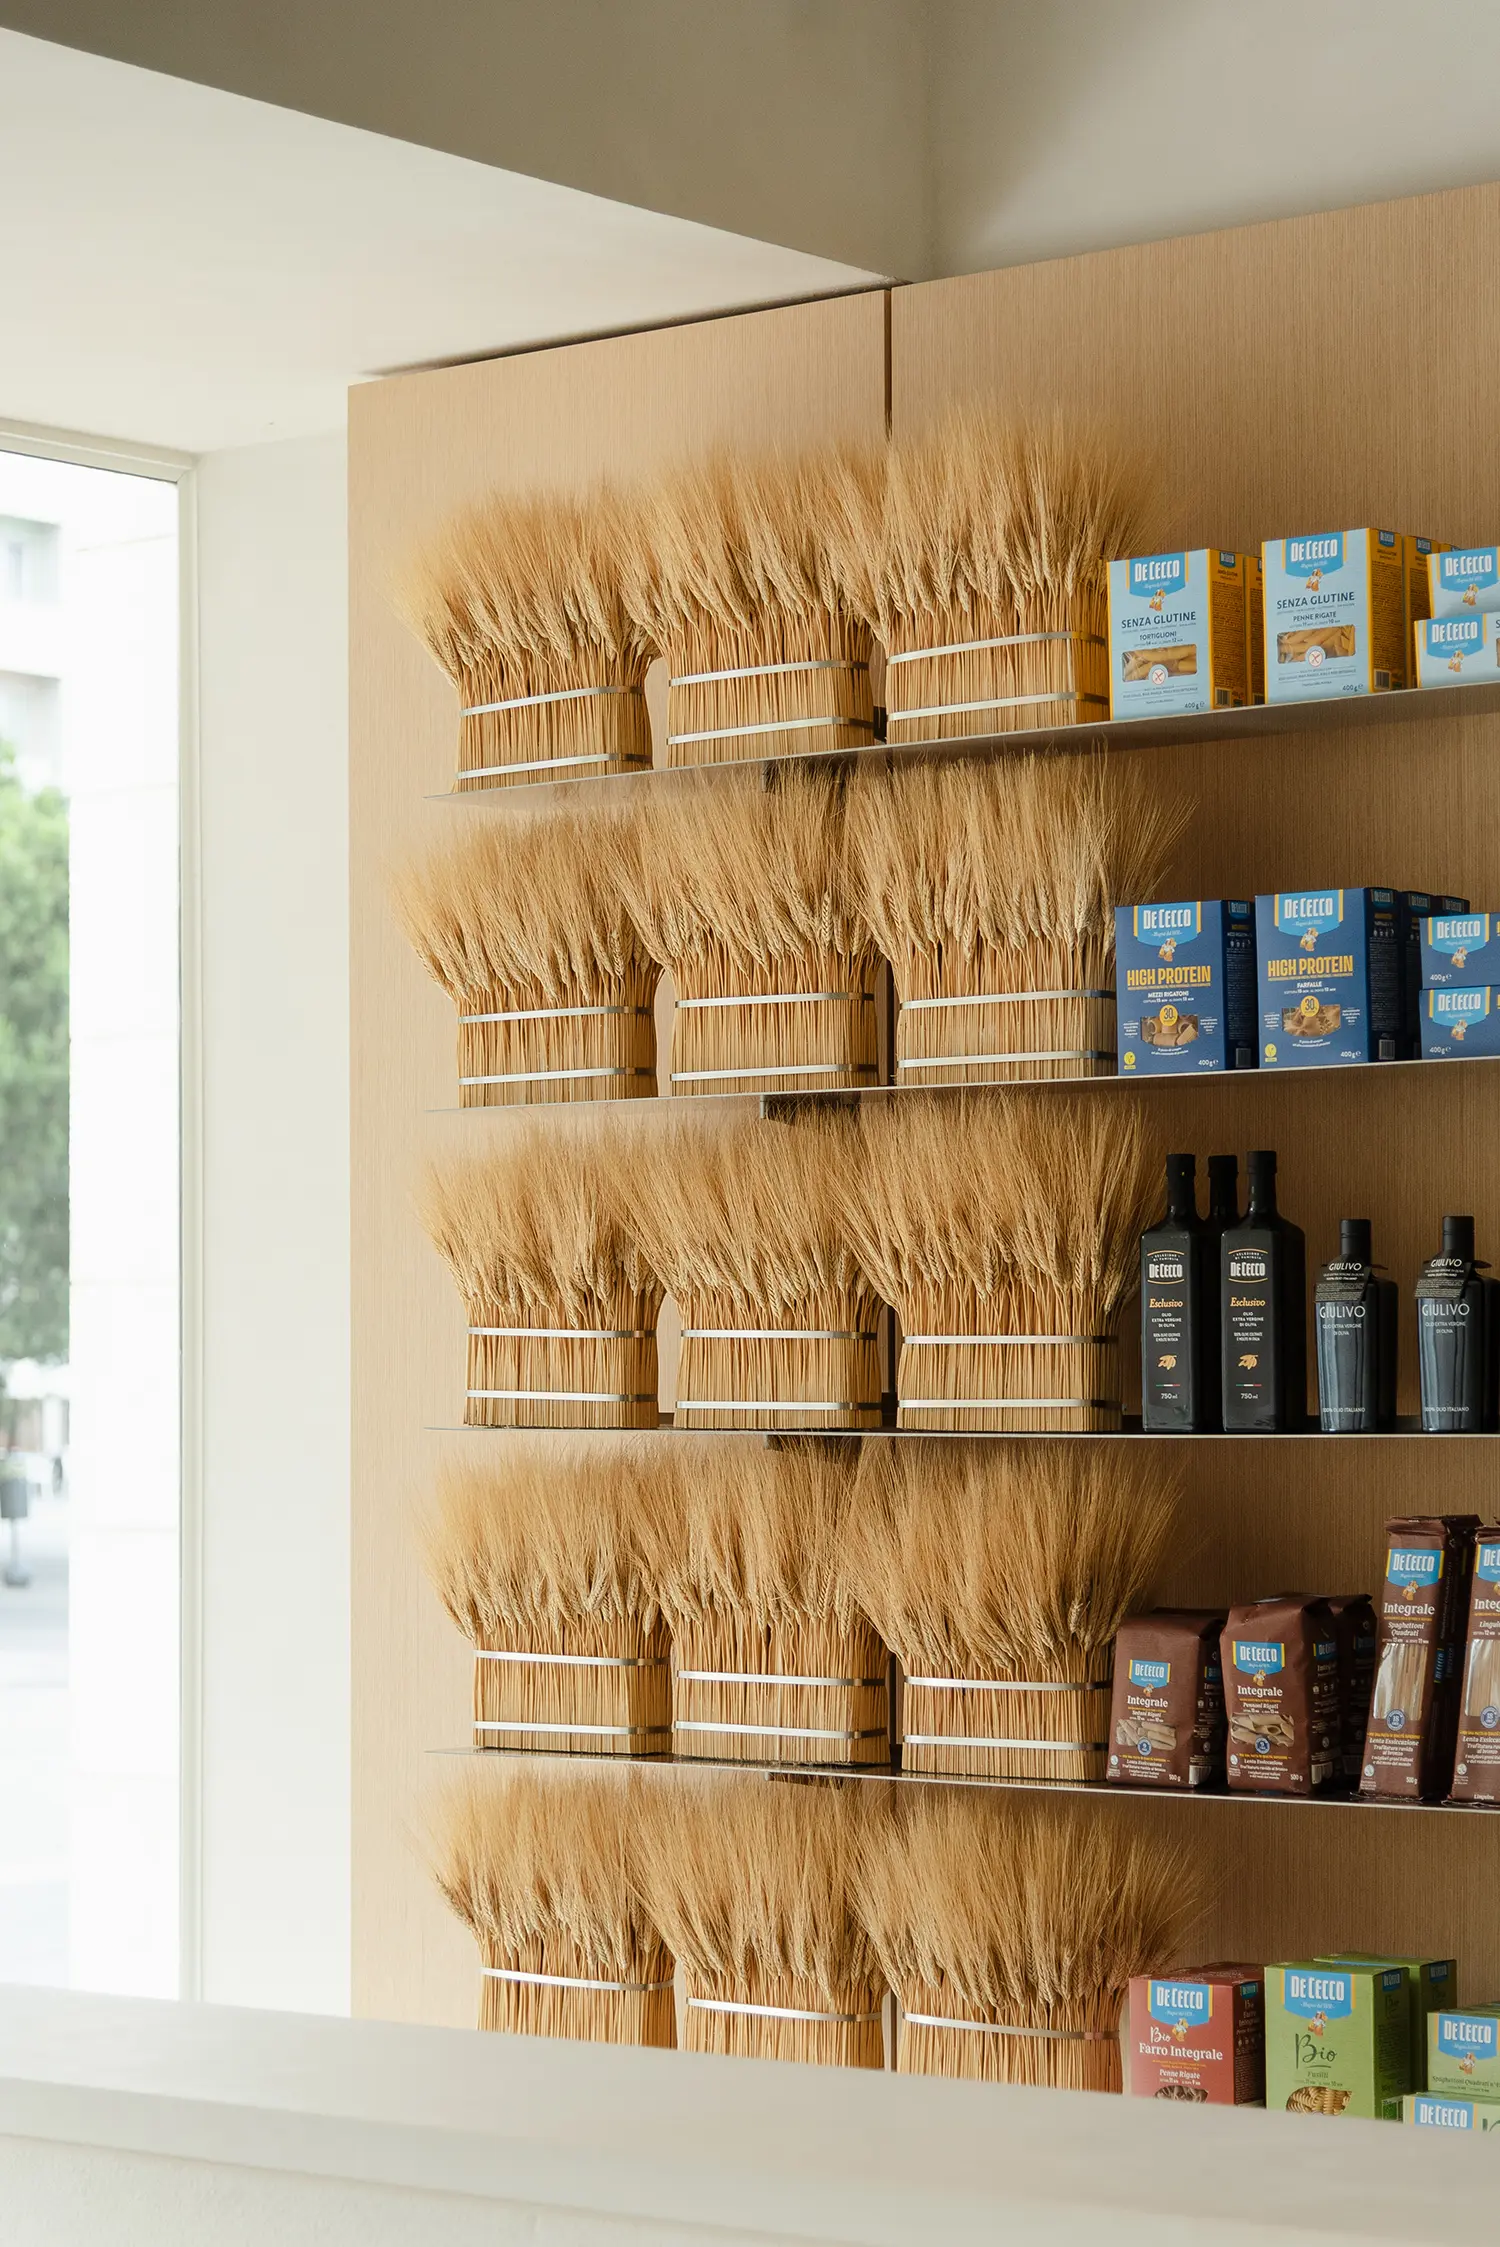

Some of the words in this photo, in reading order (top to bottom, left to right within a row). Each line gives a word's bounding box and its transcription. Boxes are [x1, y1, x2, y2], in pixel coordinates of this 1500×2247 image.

[1277, 597, 1308, 610] SENZA
[1310, 592, 1355, 604] GLUTINE
[1121, 616, 1152, 629] SENZA
[1153, 611, 1196, 624] GLUTINE
[1293, 613, 1314, 622] PENNE
[1314, 611, 1336, 620] RIGATE
[1140, 631, 1177, 640] TORTIGLIONI
[1268, 959, 1296, 977] HIGH
[1299, 956, 1353, 975] PROTEIN
[1127, 968, 1155, 986] HIGH
[1158, 966, 1211, 984] PROTEIN
[1305, 998, 1314, 1010] 30
[1164, 1008, 1173, 1019] 30
[1329, 1263, 1362, 1271] GIULIVO
[1430, 1258, 1462, 1267] GIULIVO
[1149, 1298, 1183, 1308] Esclusivo
[1230, 1296, 1265, 1307] Esclusivo
[1320, 1306, 1365, 1318] GIULIVO
[1422, 1304, 1470, 1316] GIULIVO
[1384, 1602, 1435, 1616] Integrale
[1388, 1622, 1424, 1630] Spaghettoni
[1391, 1629, 1419, 1637] Quadrati
[1237, 1685, 1283, 1698] Integrale
[1127, 1695, 1168, 1708] Integrale
[1150, 2026, 1171, 2043] Bio
[1139, 2042, 1168, 2056] Farro
[1170, 2045, 1223, 2062] Integrale
[1295, 2033, 1337, 2069] Bio
[1160, 2069, 1178, 2077] Penne
[1180, 2070, 1200, 2079] Rigate
